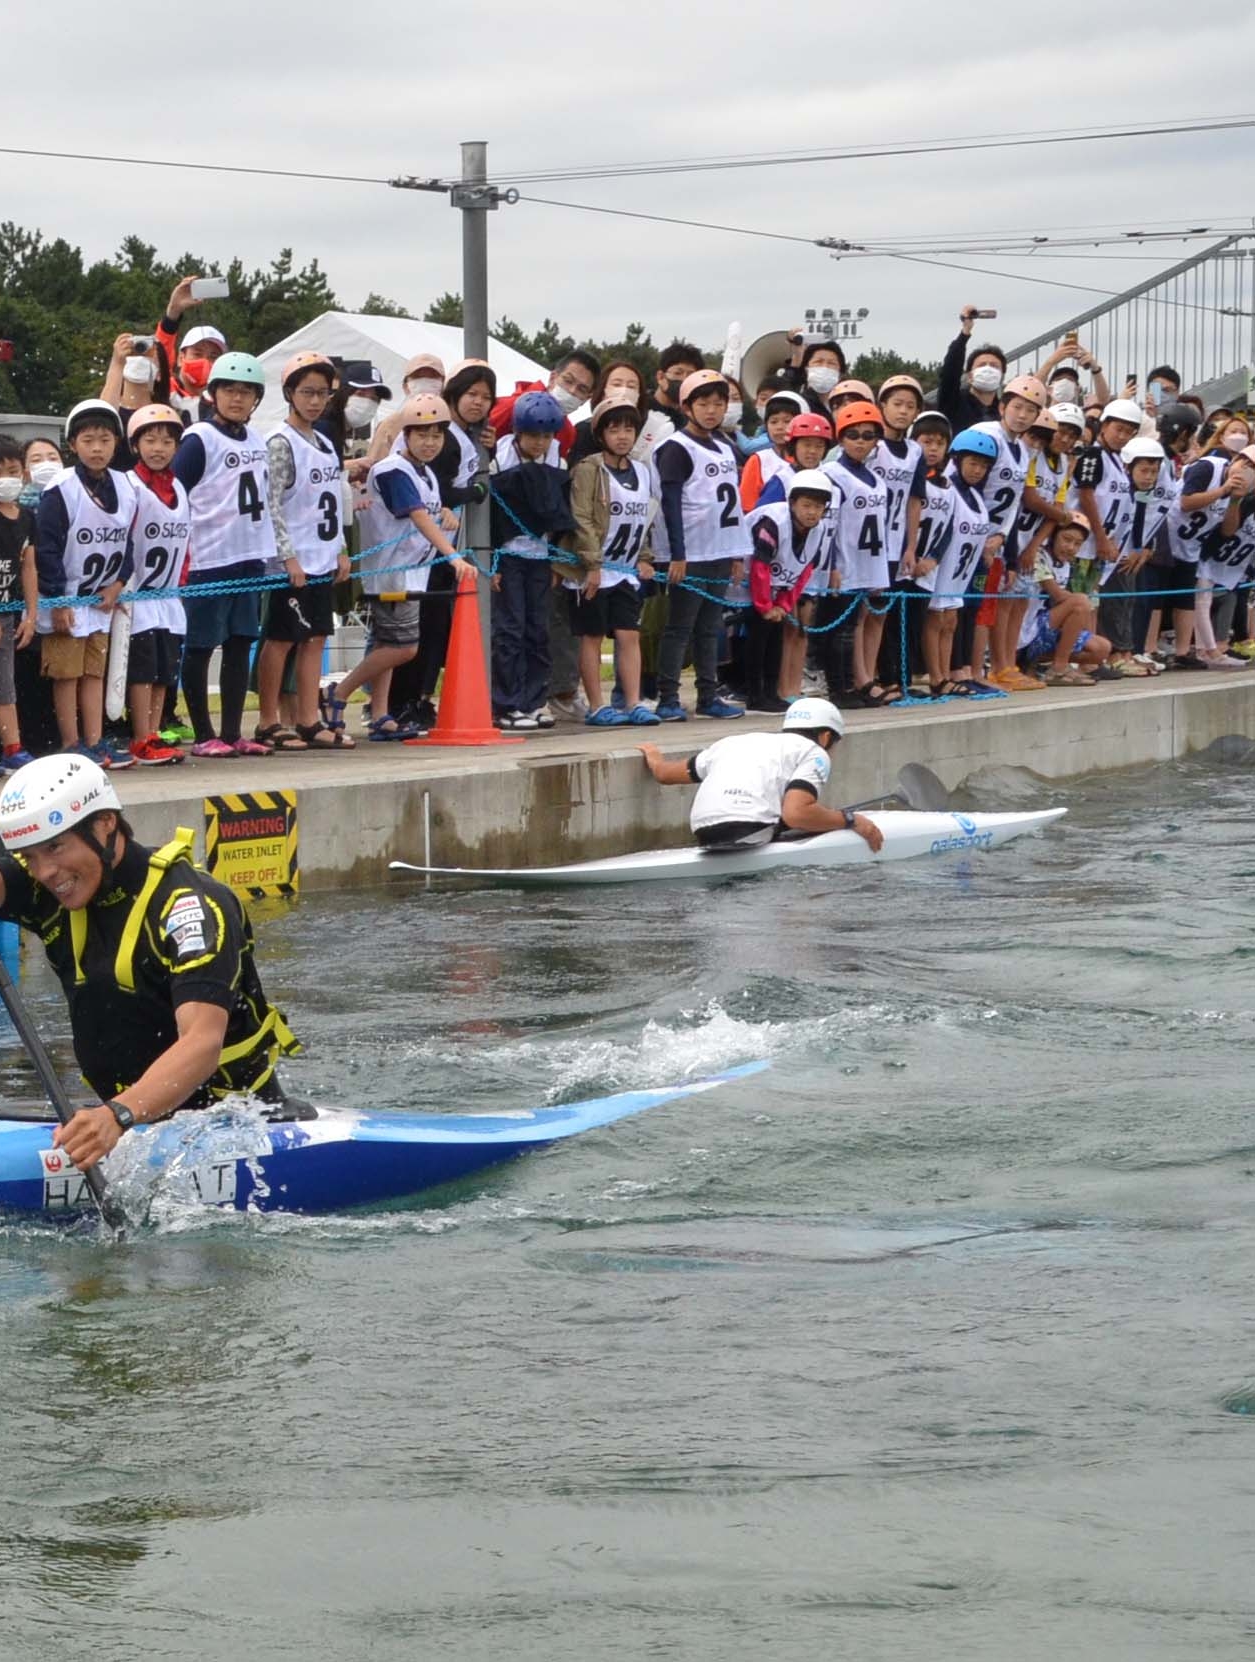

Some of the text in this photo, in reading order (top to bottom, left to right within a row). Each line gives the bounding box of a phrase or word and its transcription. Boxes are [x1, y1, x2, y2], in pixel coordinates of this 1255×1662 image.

[318, 491, 338, 541] 3
[83, 788, 100, 806] JAL
[220, 816, 284, 839] WARNING
[223, 844, 282, 861] WATER INLET
[230, 871, 255, 886] KEEP
